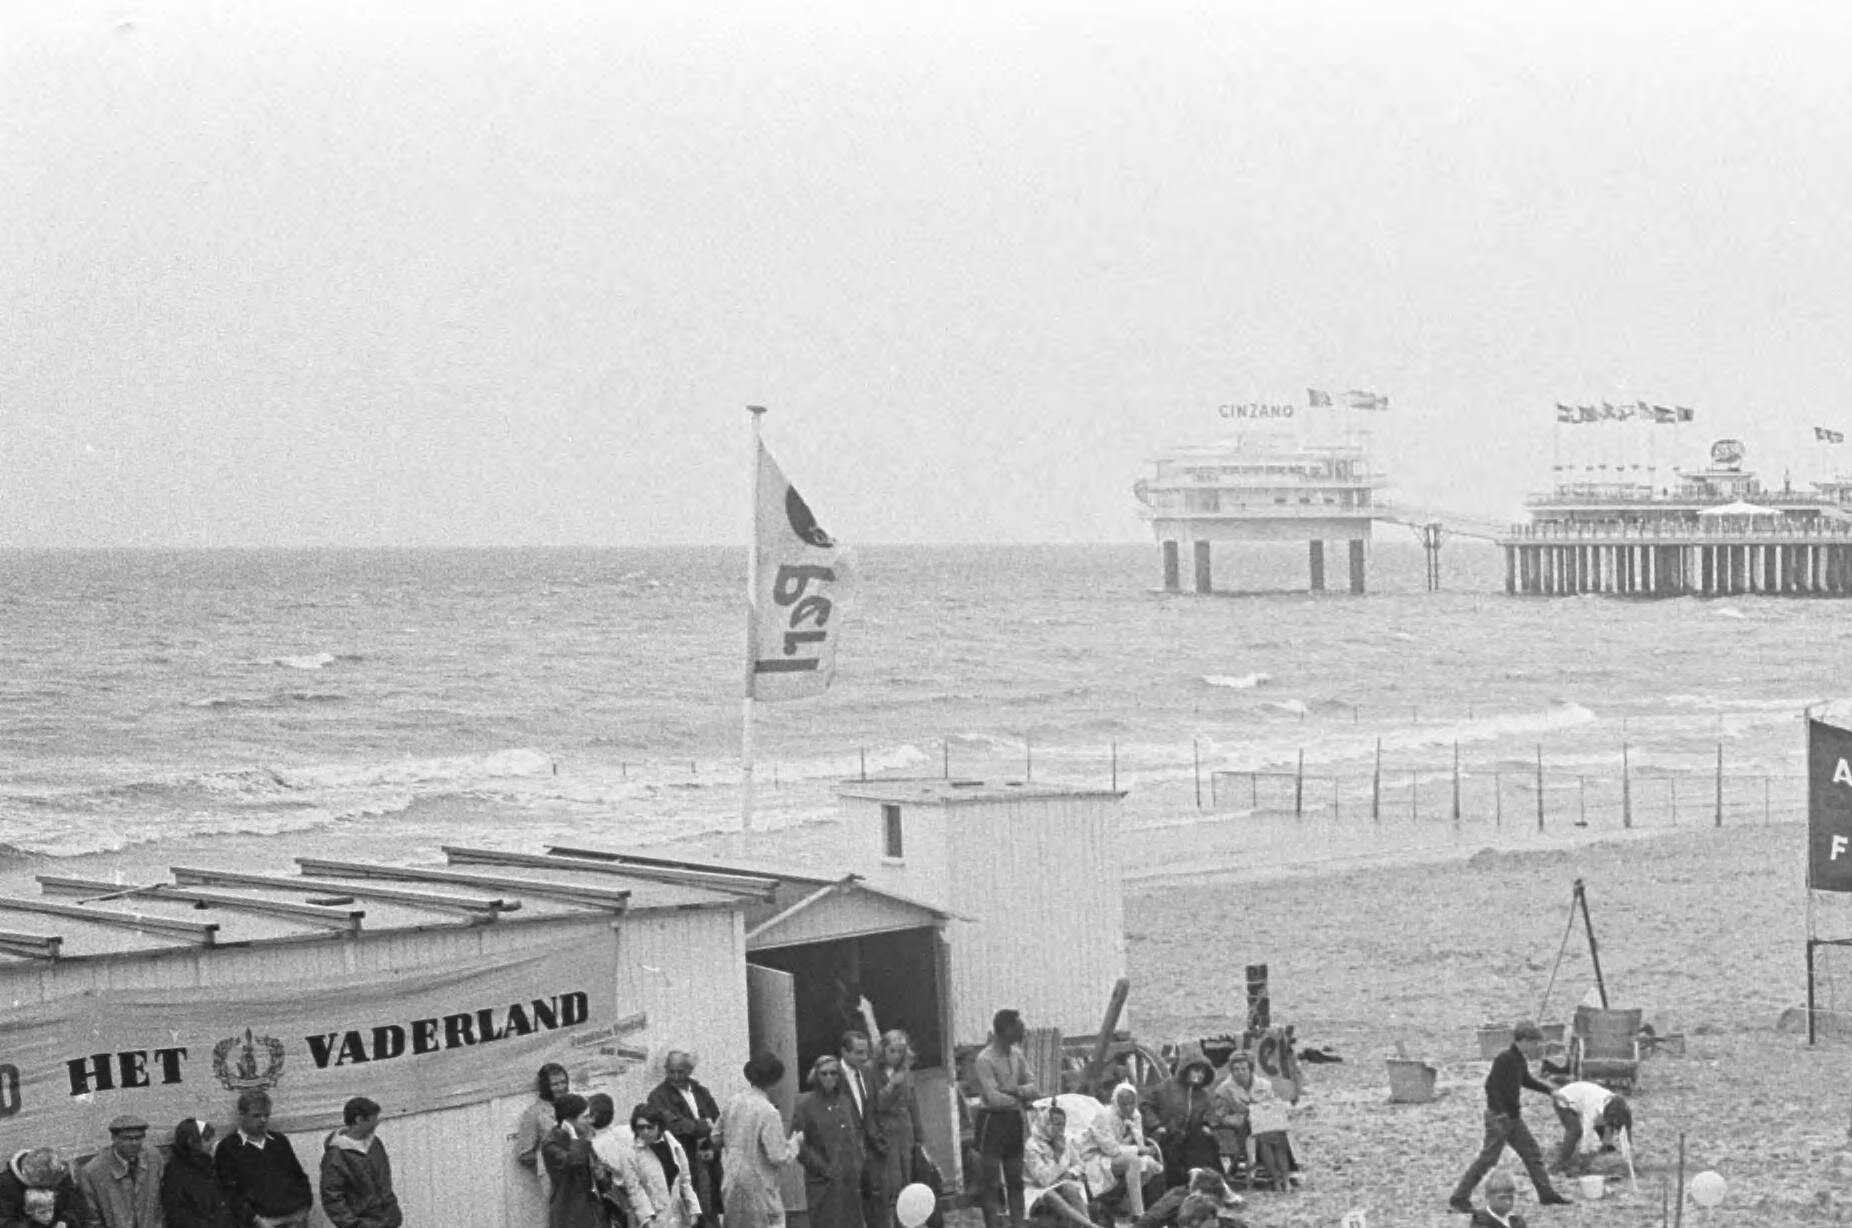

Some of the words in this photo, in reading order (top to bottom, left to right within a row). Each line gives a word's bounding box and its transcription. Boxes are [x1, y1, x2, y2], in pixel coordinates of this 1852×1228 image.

[1219, 404, 1294, 418] CINZANO
[1829, 834, 1849, 861] F
[66, 1047, 188, 1097] HET
[304, 990, 590, 1070] VADERLAND
